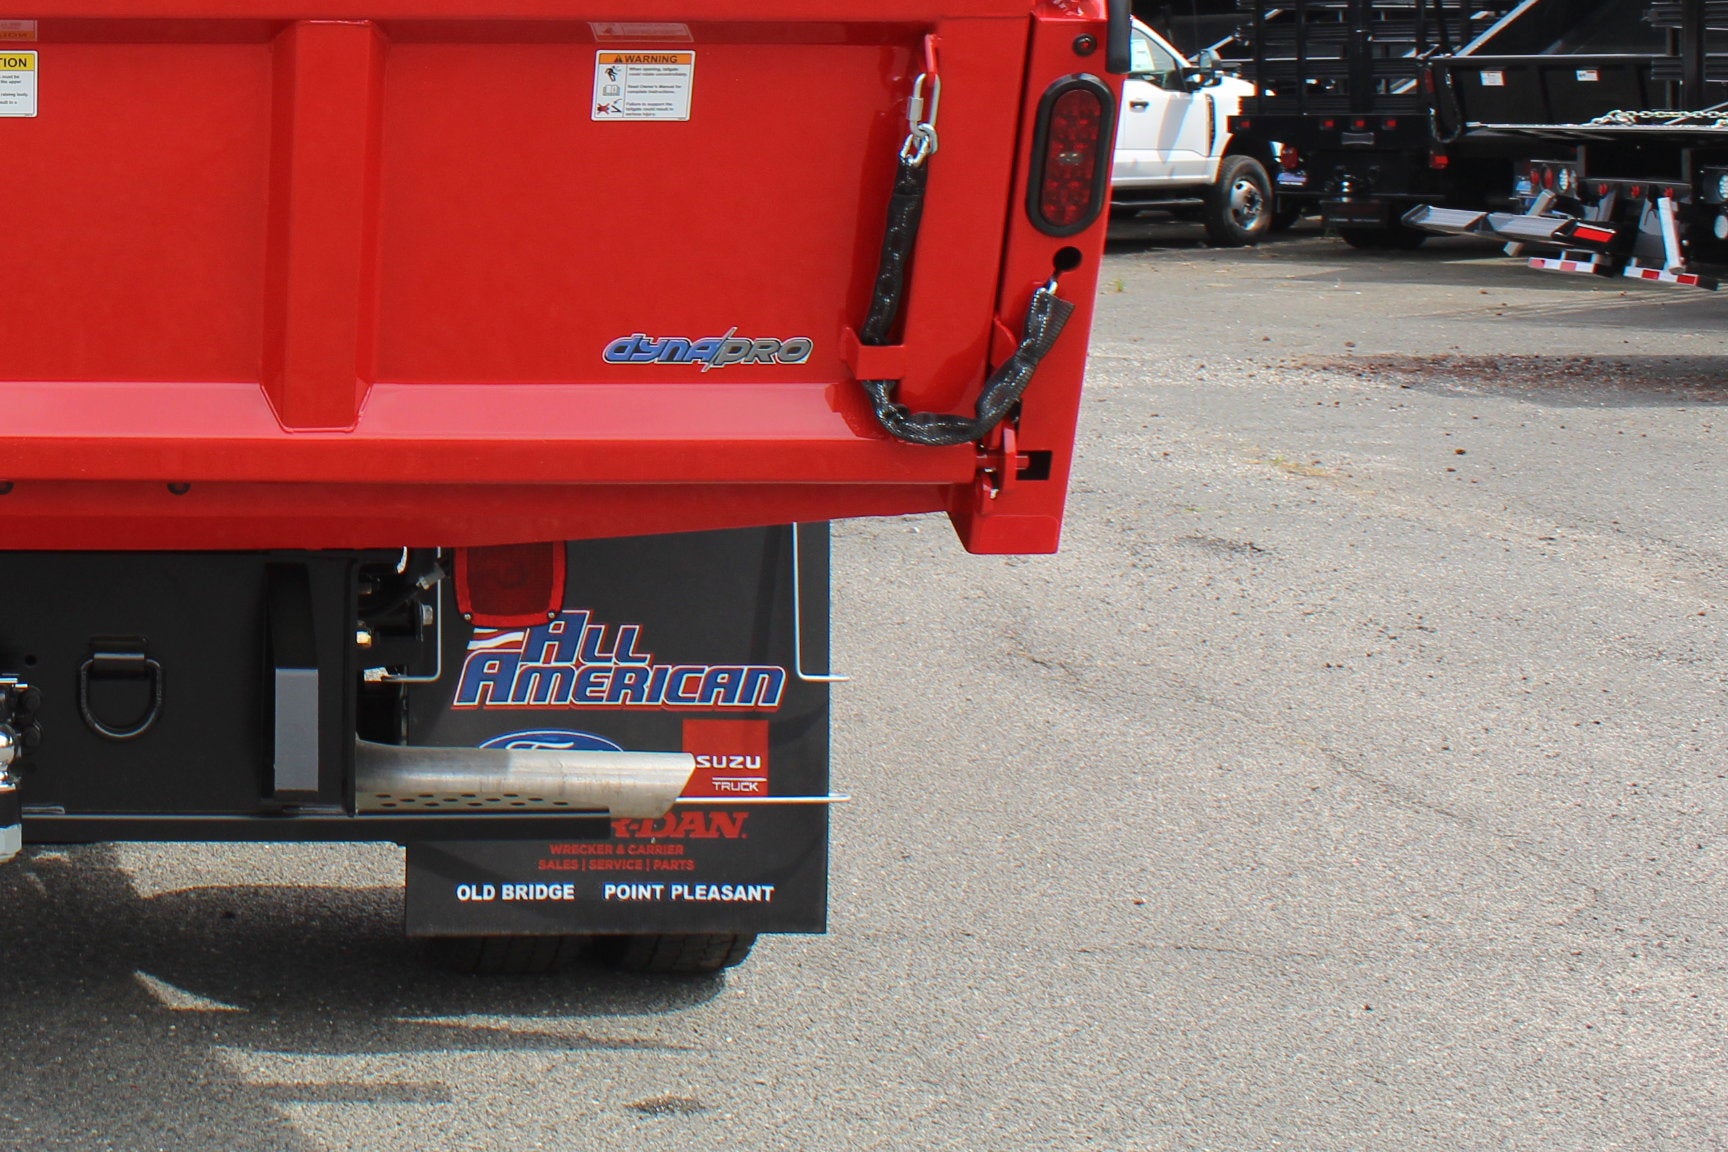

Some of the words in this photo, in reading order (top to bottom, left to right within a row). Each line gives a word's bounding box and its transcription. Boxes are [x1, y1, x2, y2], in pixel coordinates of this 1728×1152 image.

[625, 55, 678, 63] WARNING
[520, 610, 653, 665] ALL
[452, 649, 786, 711] AMERICAN
[696, 755, 761, 769] SUZU
[712, 782, 759, 792] TRUCK
[550, 844, 613, 855] WRECKER
[616, 844, 625, 855] &
[628, 844, 685, 856] CARRIER
[538, 859, 579, 871] SALES
[589, 860, 643, 871] SERVICE
[653, 860, 696, 871] PARTS
[457, 884, 496, 901] OLD
[502, 884, 575, 901] BRIDGE
[605, 885, 664, 900] POINT
[671, 885, 774, 902] PLEASANT
